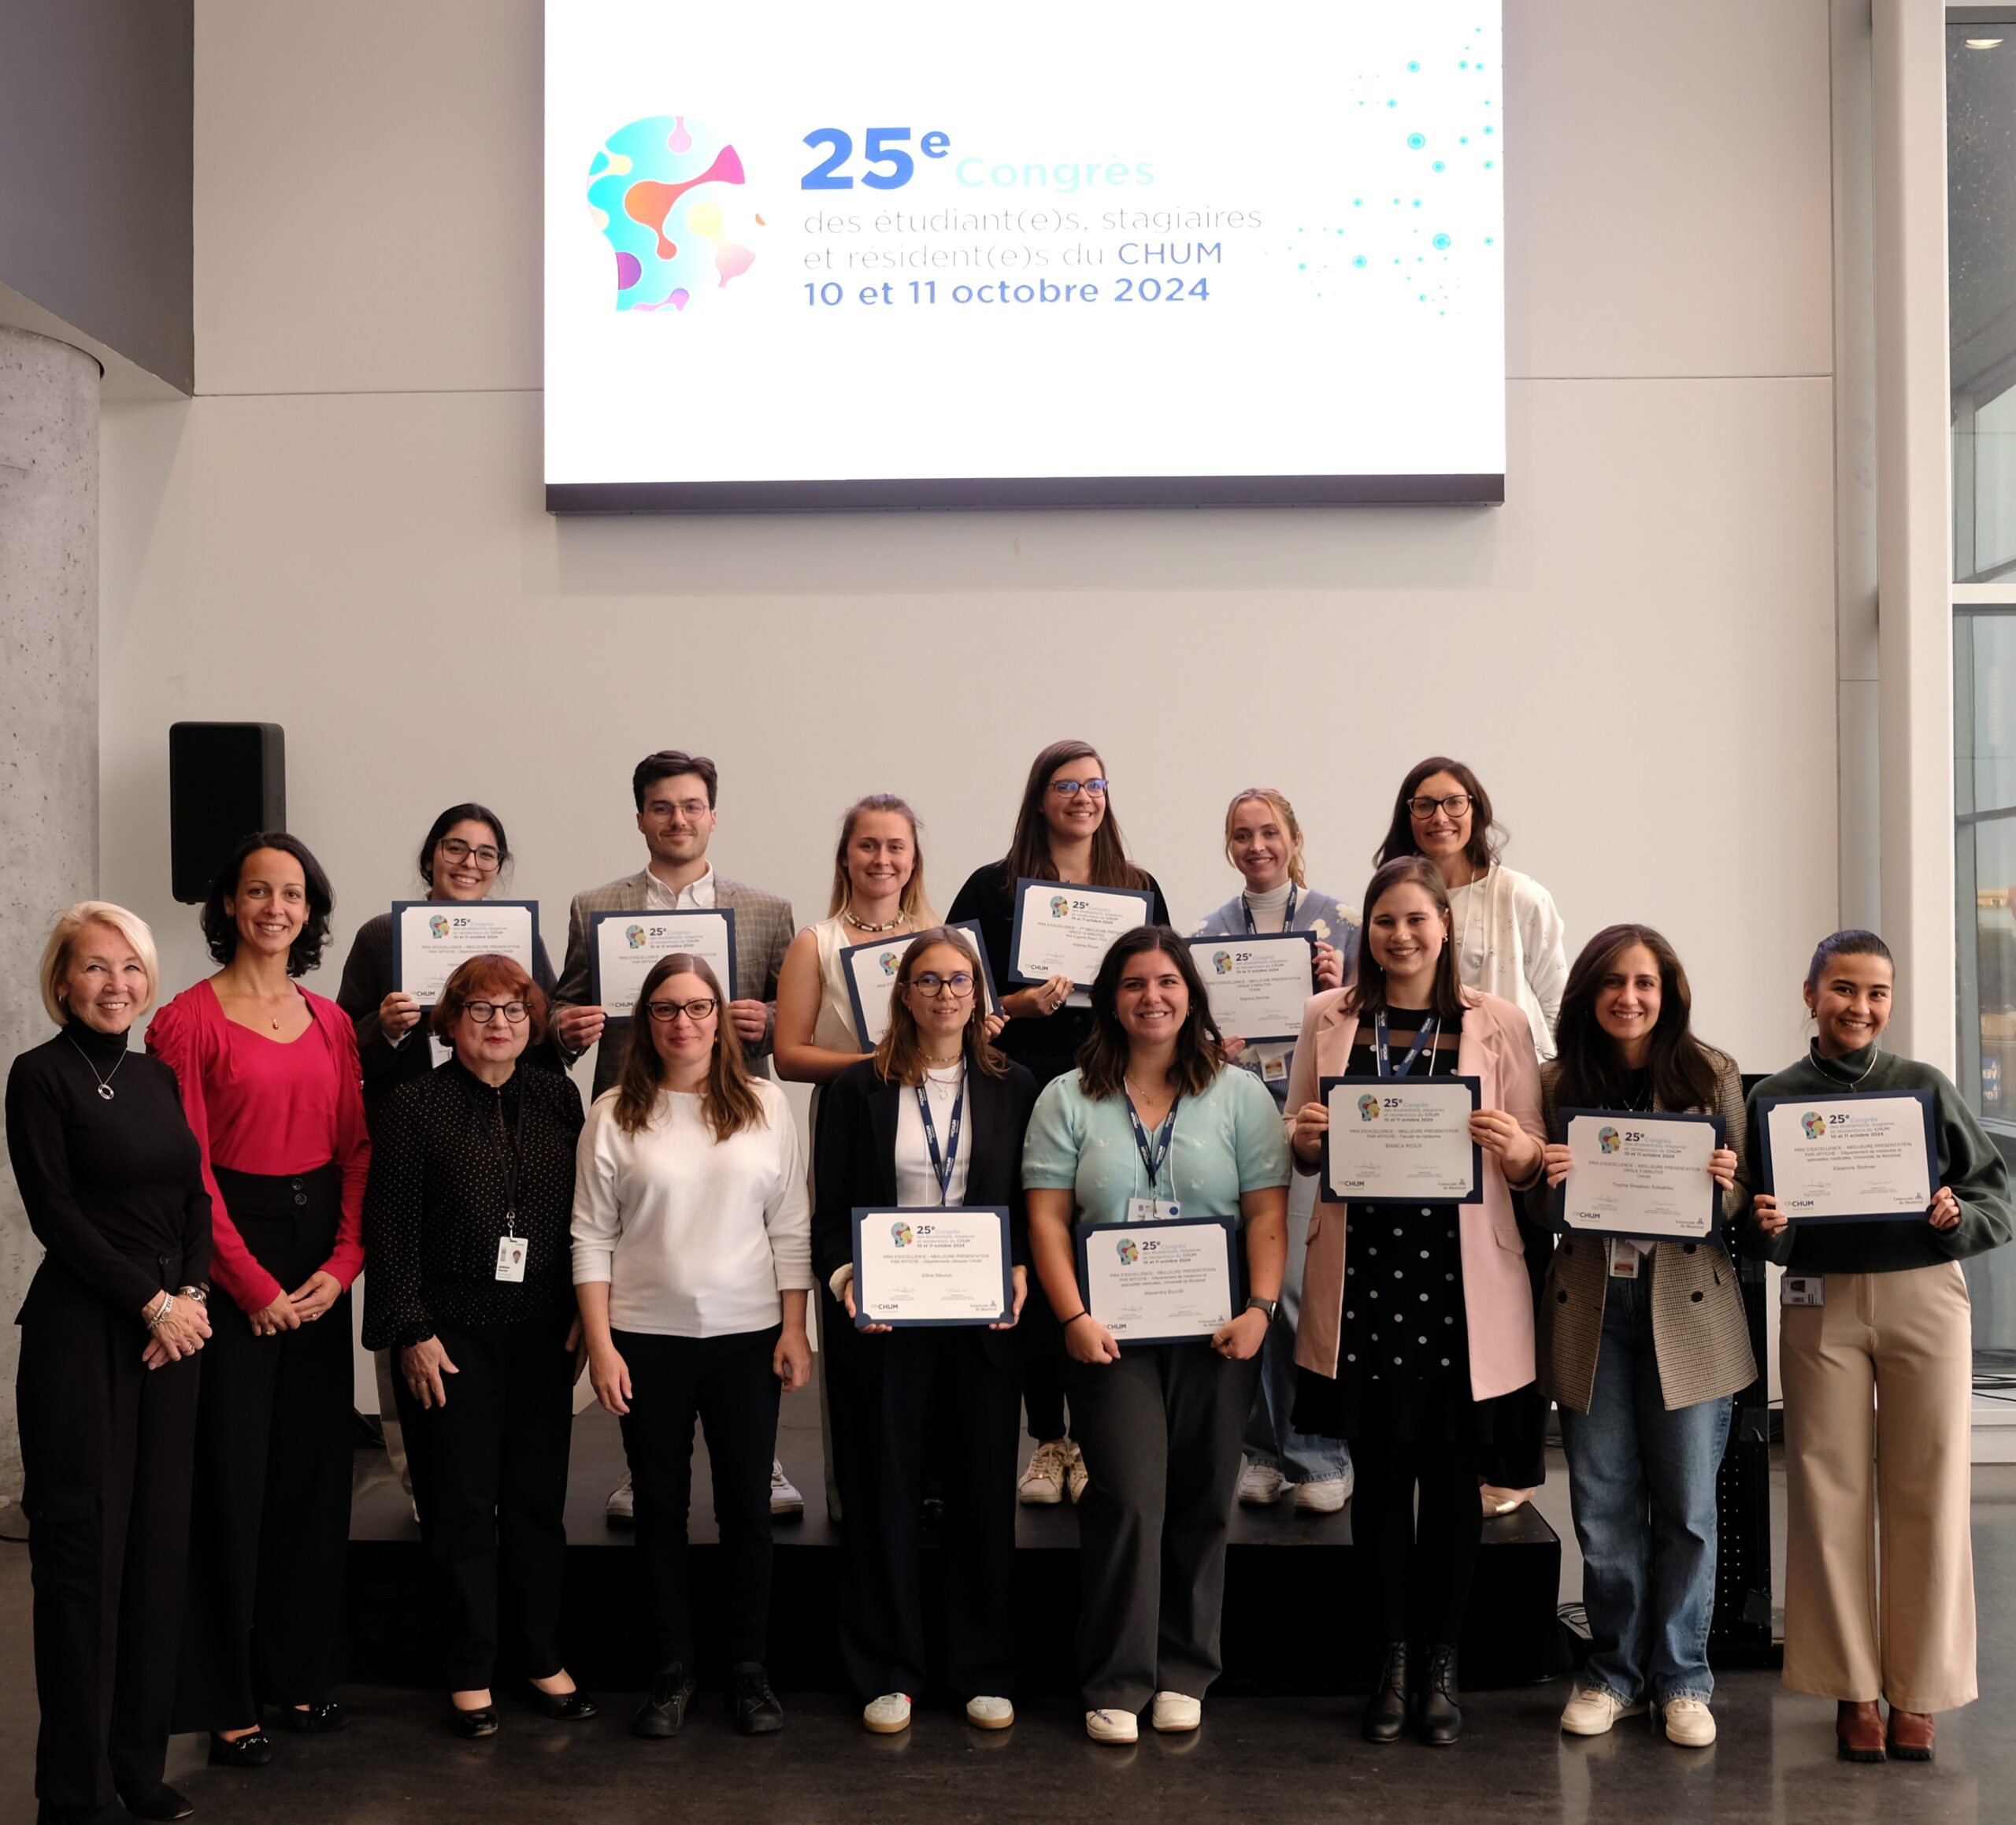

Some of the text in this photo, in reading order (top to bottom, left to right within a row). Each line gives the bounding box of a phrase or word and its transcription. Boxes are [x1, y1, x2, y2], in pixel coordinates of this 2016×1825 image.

[801, 127, 1154, 193] 25e Congrès
[805, 206, 1262, 234] des étudiant(e)s, stagiaires
[804, 242, 1221, 269] et résident(e)s du CHUM
[804, 277, 1210, 306] 10 et 11 octobre 2024
